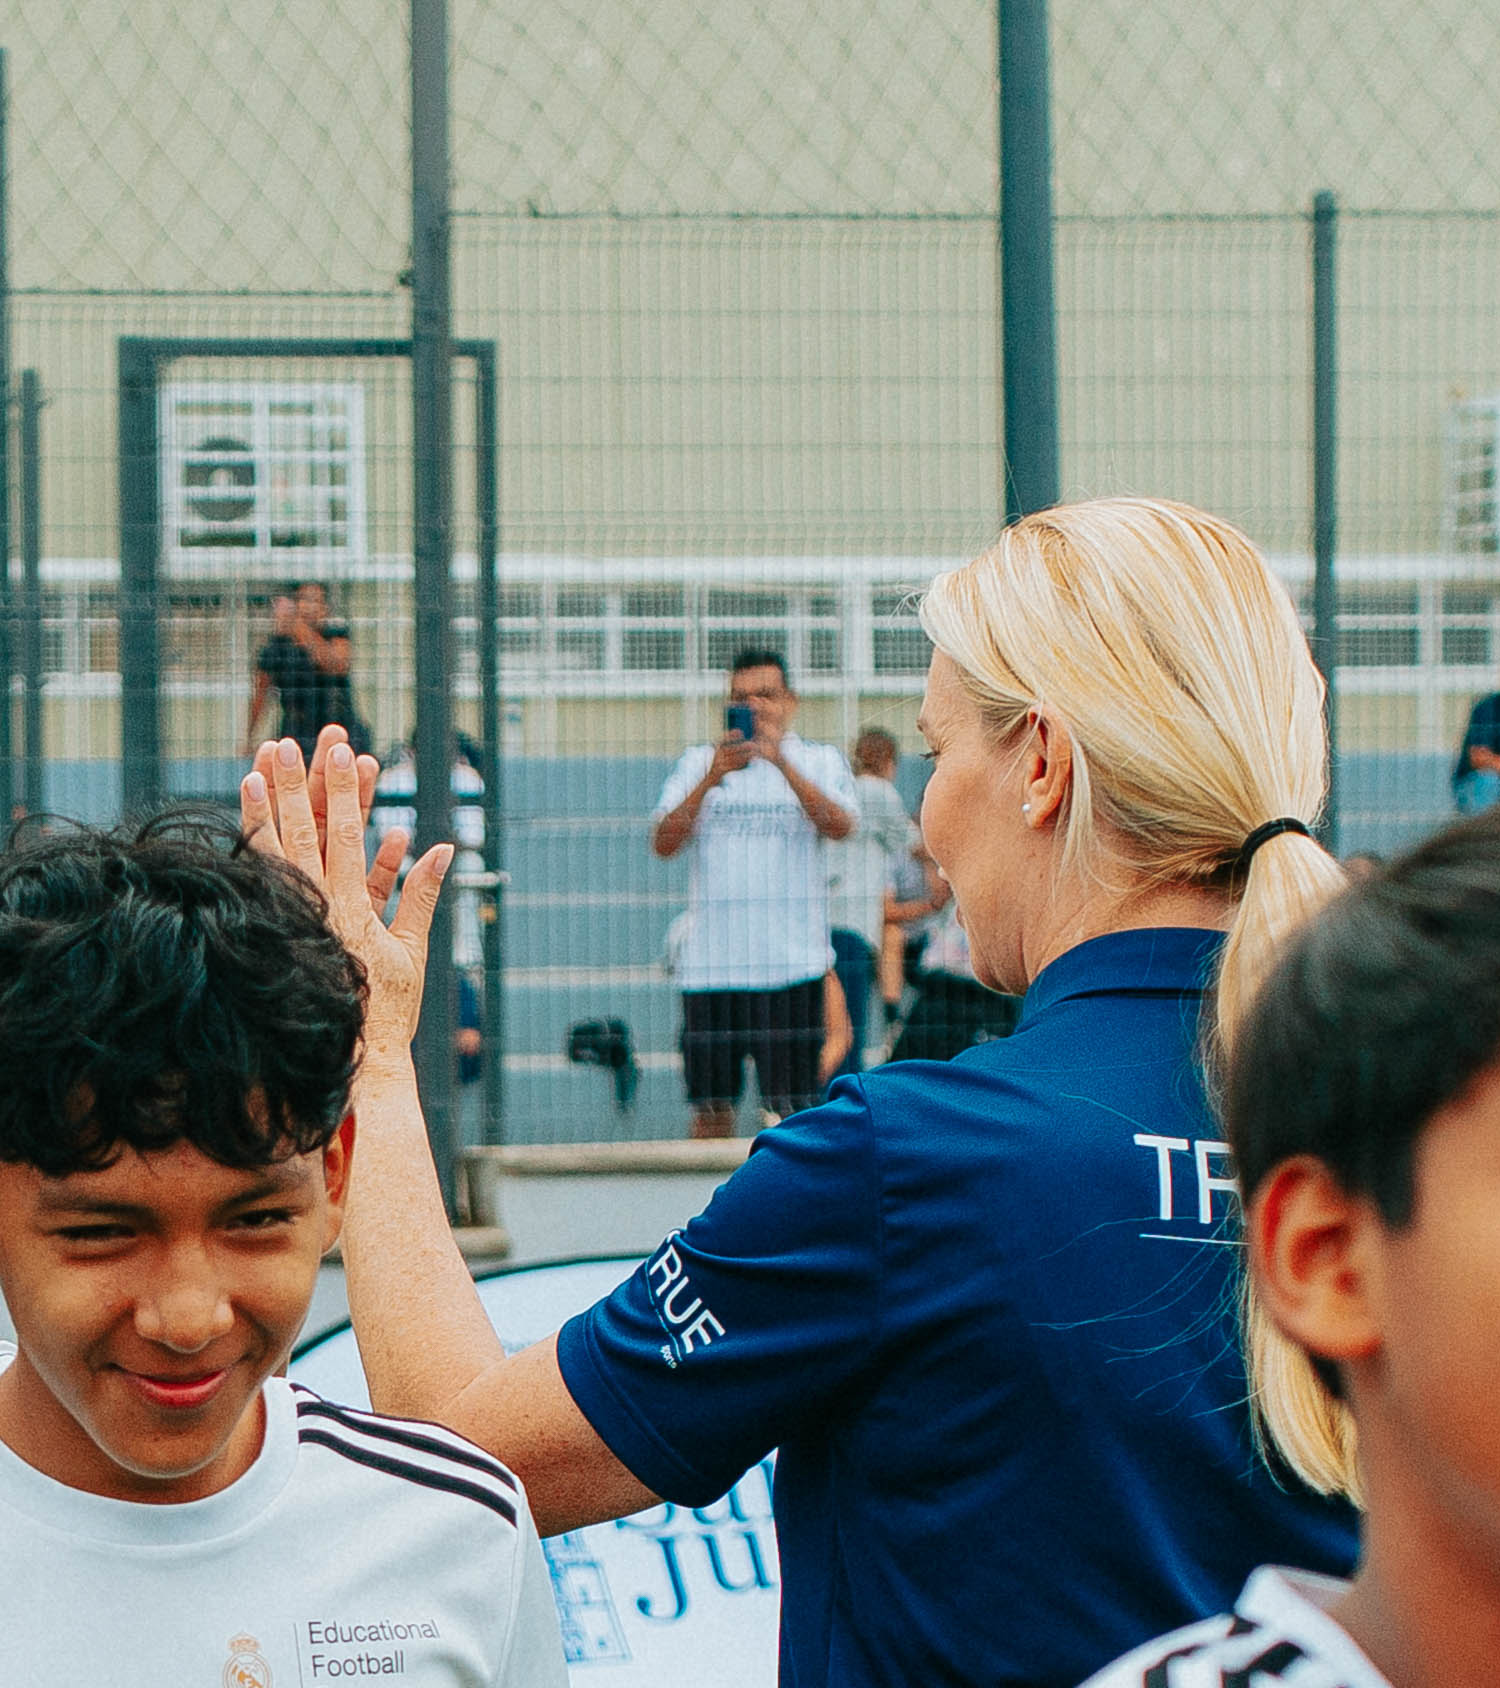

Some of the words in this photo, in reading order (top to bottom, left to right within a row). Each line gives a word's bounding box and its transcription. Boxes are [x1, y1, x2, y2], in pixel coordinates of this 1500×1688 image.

[649, 1229, 727, 1355] RUE
[307, 1618, 441, 1645] Educational
[311, 1650, 405, 1678] Football
